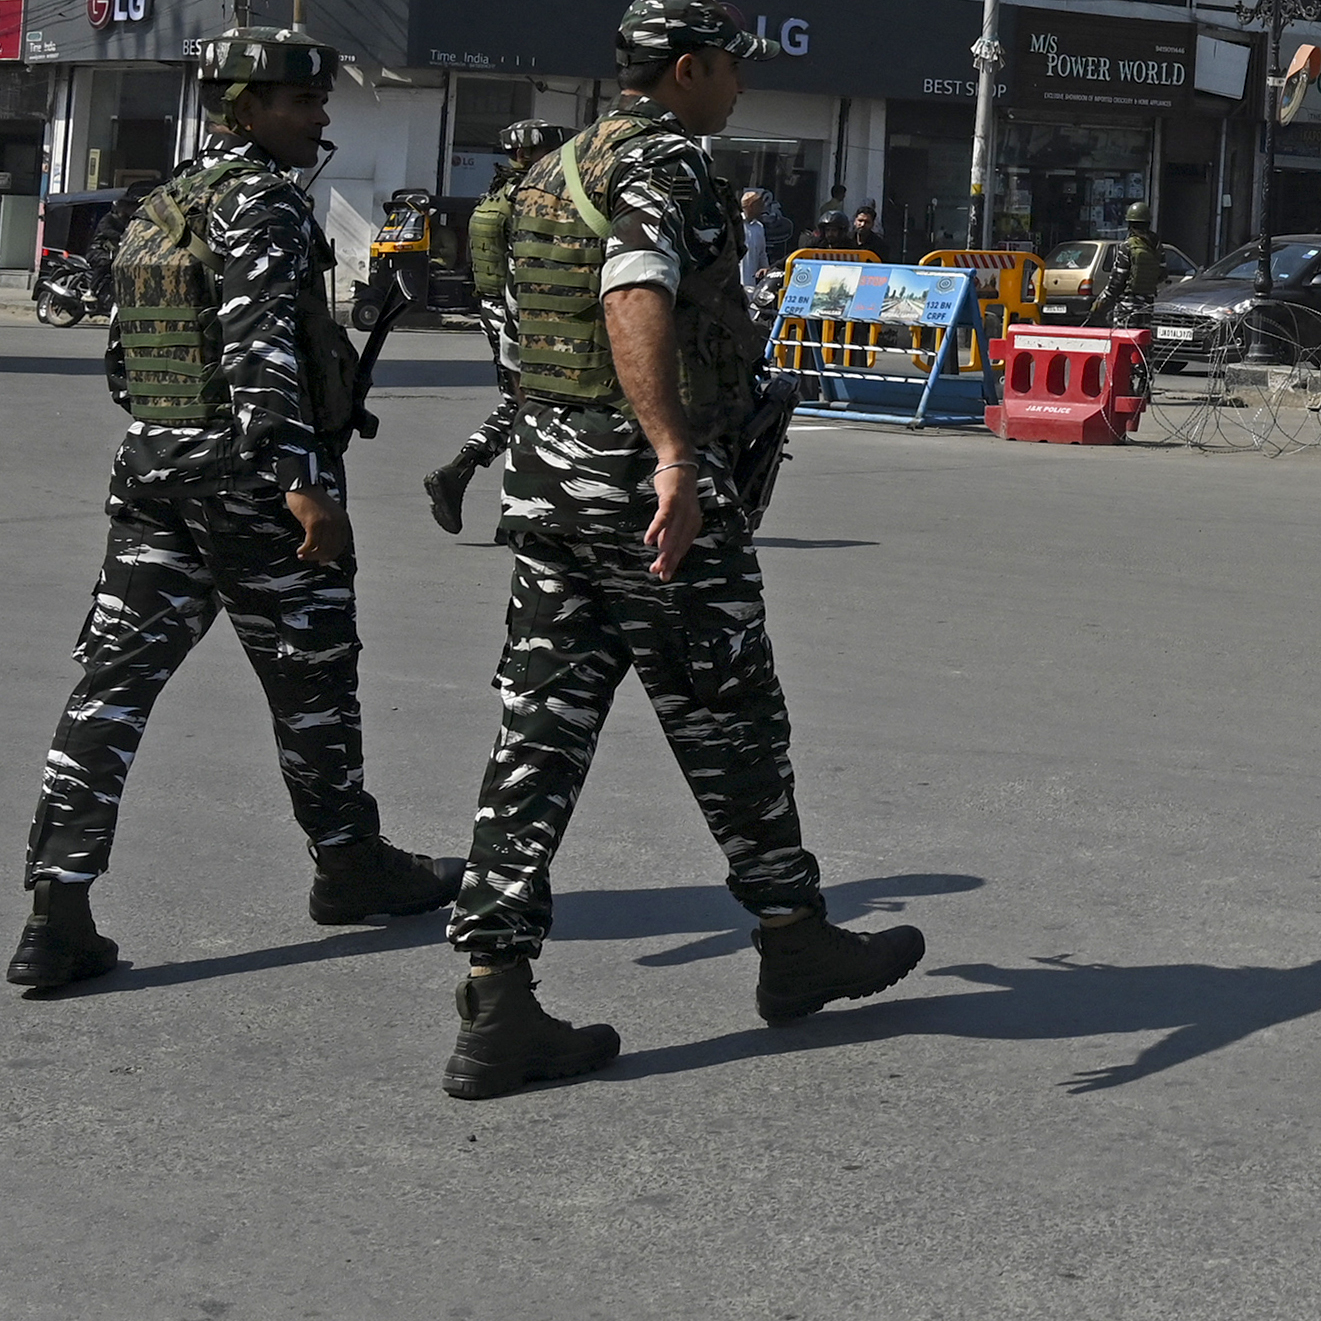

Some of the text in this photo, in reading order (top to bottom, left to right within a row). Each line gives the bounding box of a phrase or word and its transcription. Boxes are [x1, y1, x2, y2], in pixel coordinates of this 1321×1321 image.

[182, 38, 202, 56] BES
[1030, 33, 1059, 55] M/S
[429, 49, 457, 63] Time
[463, 52, 490, 65] India
[1046, 53, 1186, 86] POWER WORLD
[923, 78, 963, 95] BEST
[785, 295, 809, 304] 132 BN
[926, 301, 951, 310] 132 BN
[784, 305, 805, 315] CRPF
[926, 312, 947, 321] CRPF
[1043, 406, 1072, 414] POLICE
